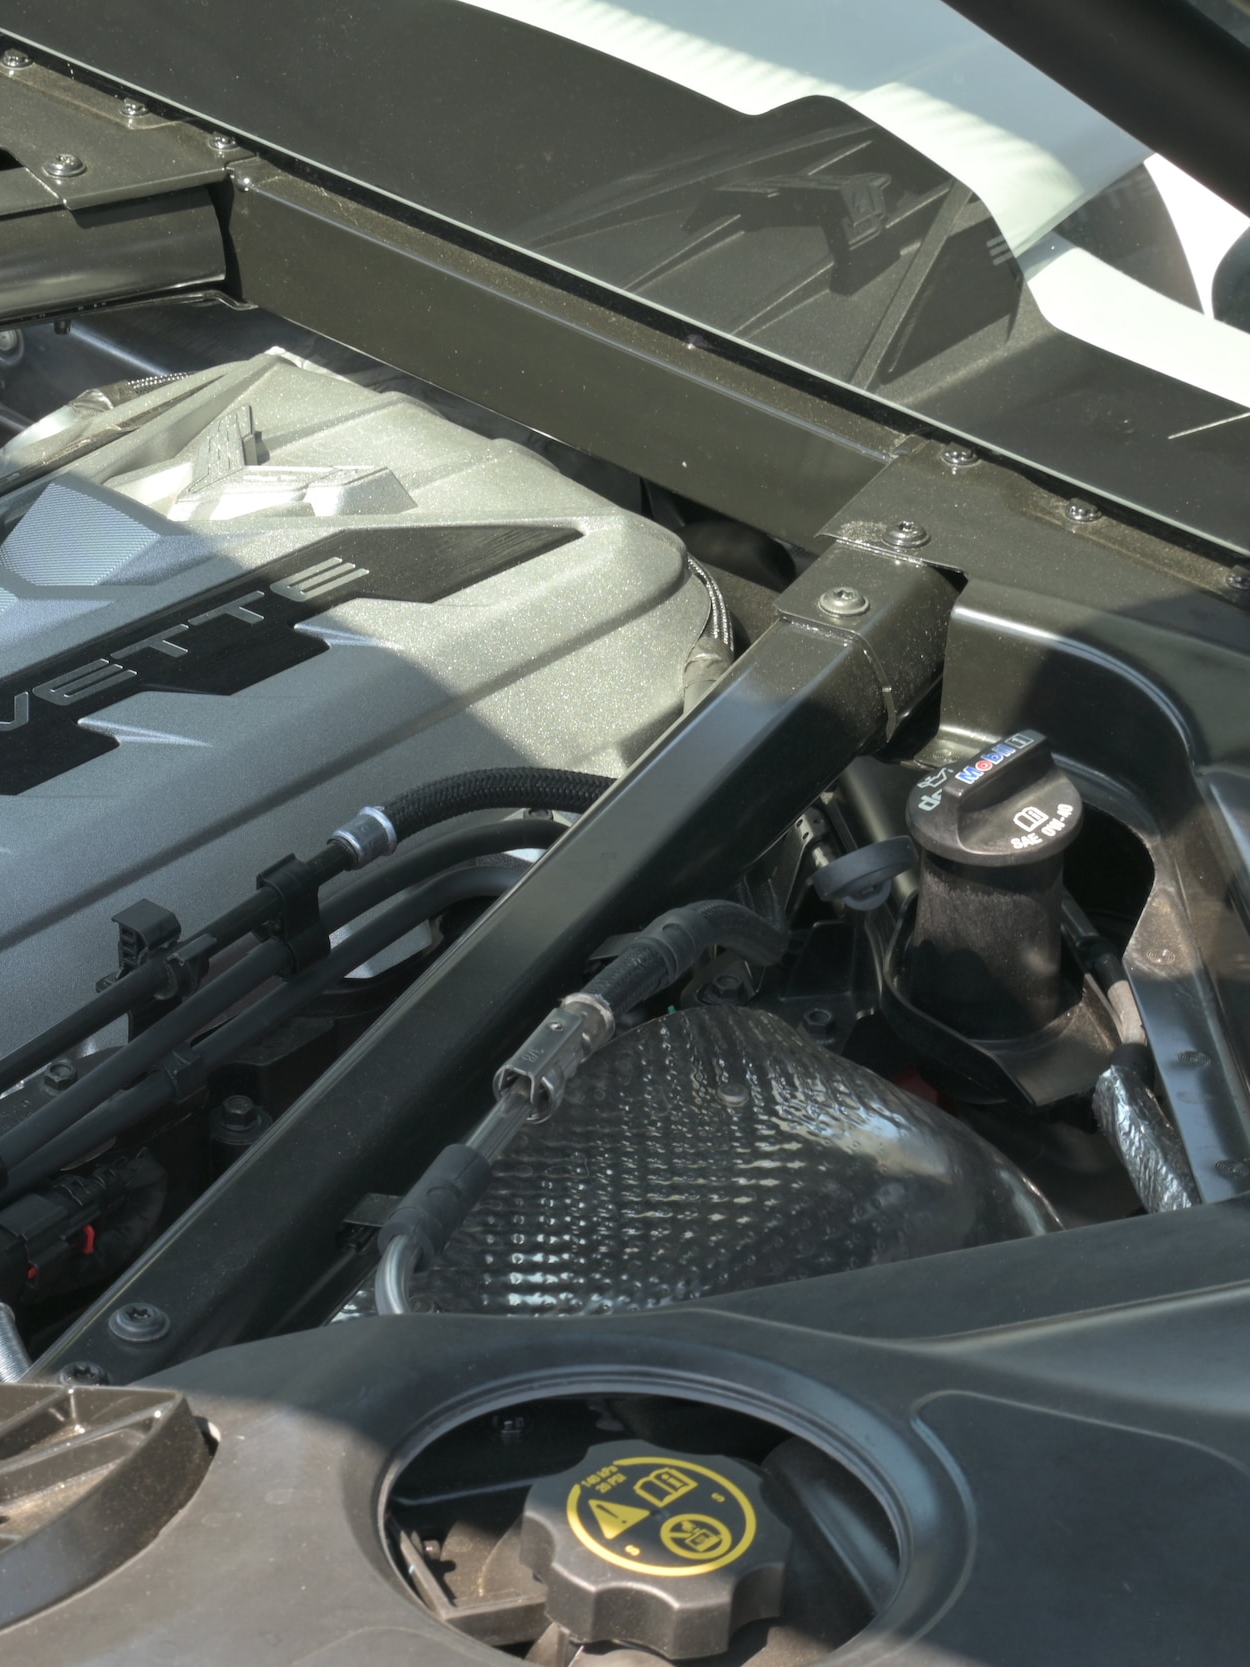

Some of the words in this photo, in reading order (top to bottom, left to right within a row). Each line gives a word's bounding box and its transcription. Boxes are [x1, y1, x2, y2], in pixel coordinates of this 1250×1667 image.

[955, 743, 1017, 785] Mobil
[1010, 832, 1043, 849] SAE
[1041, 803, 1073, 837] 0W-40
